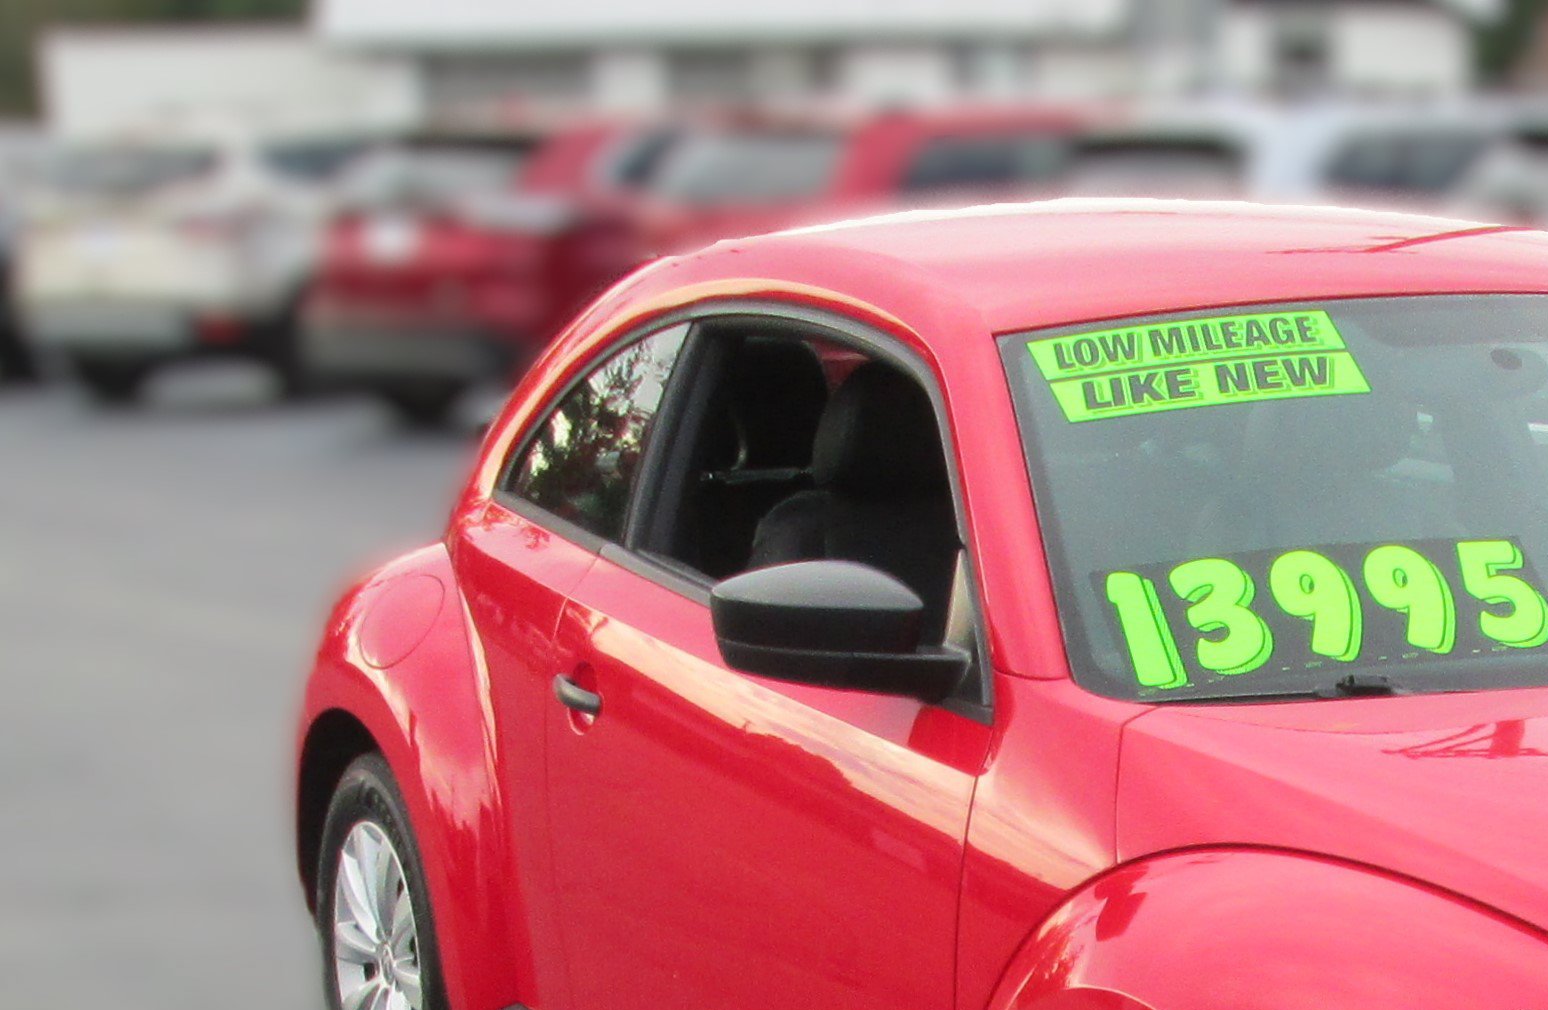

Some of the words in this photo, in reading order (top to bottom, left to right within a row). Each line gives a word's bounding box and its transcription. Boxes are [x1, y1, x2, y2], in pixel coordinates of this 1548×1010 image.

[1052, 331, 1141, 372] LOW
[1148, 315, 1321, 357] MILEAGE
[1081, 367, 1201, 413] LIKE
[1213, 355, 1333, 397] NEW
